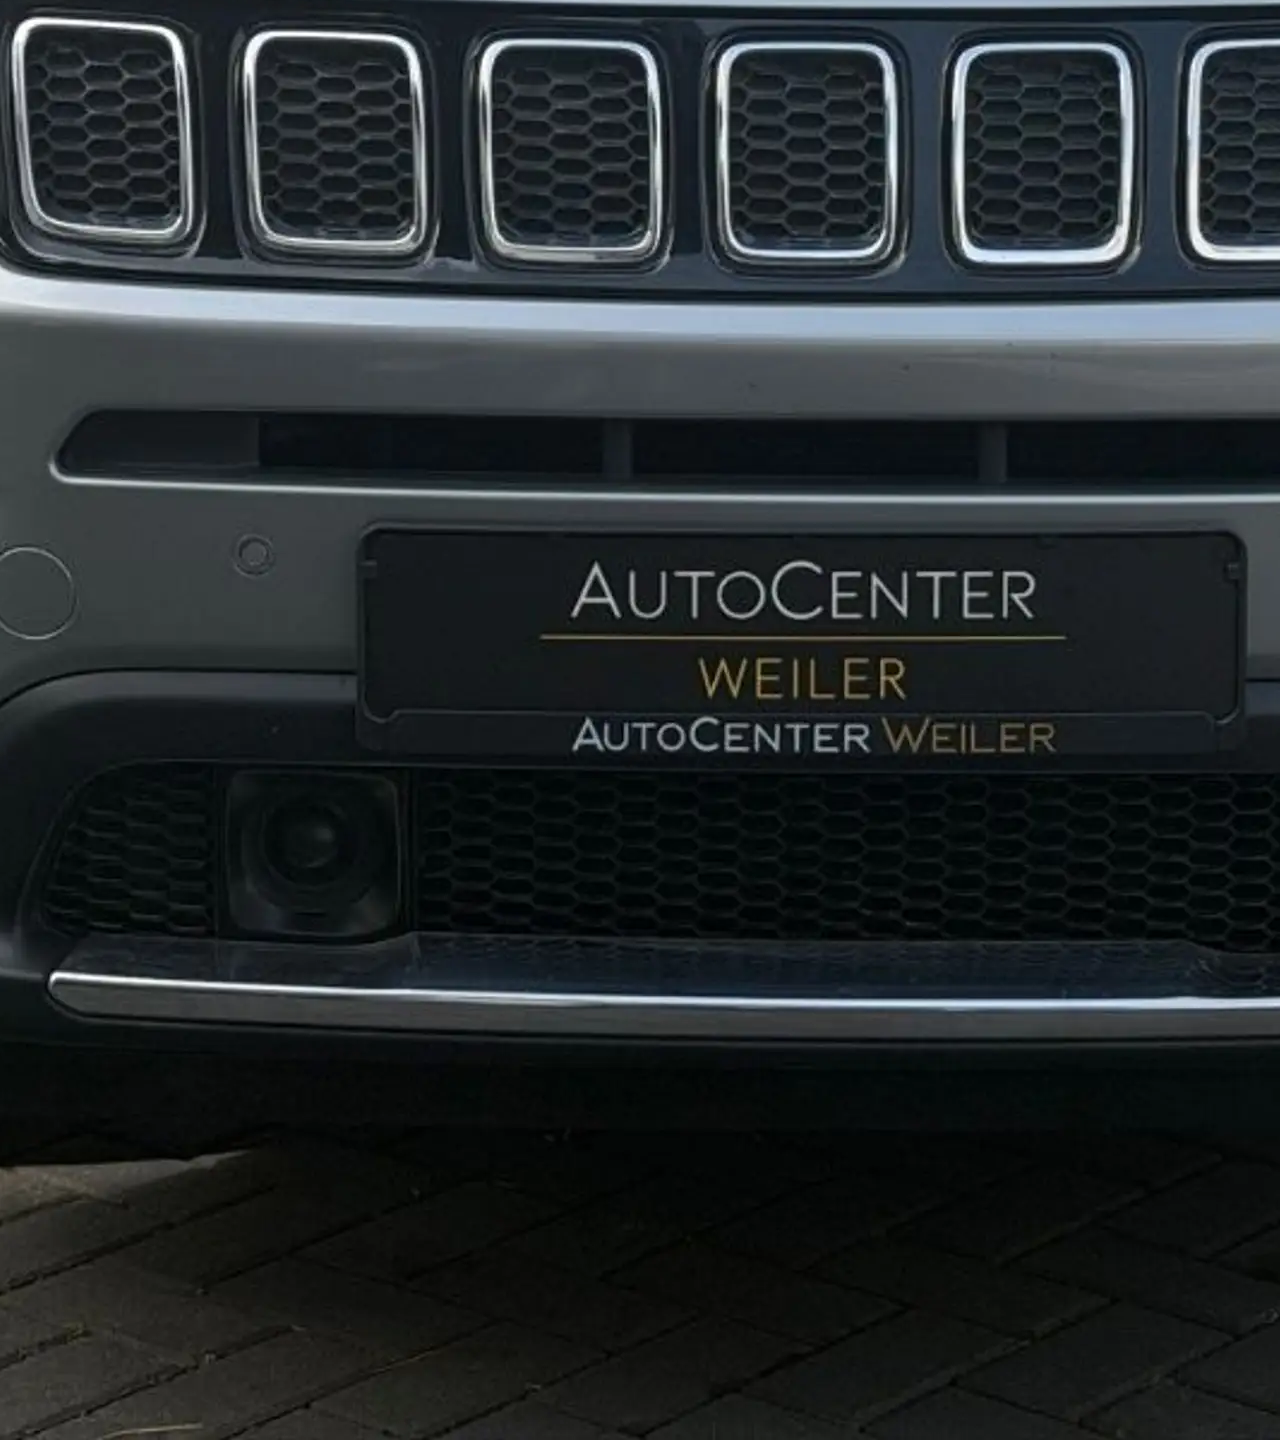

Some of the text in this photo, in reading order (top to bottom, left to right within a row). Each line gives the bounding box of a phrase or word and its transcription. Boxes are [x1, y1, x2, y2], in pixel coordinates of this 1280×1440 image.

[569, 559, 1037, 622] AUTOCENTER
[699, 656, 907, 700] WEILER
[571, 715, 1057, 754] AUTOCENTER WEILER
